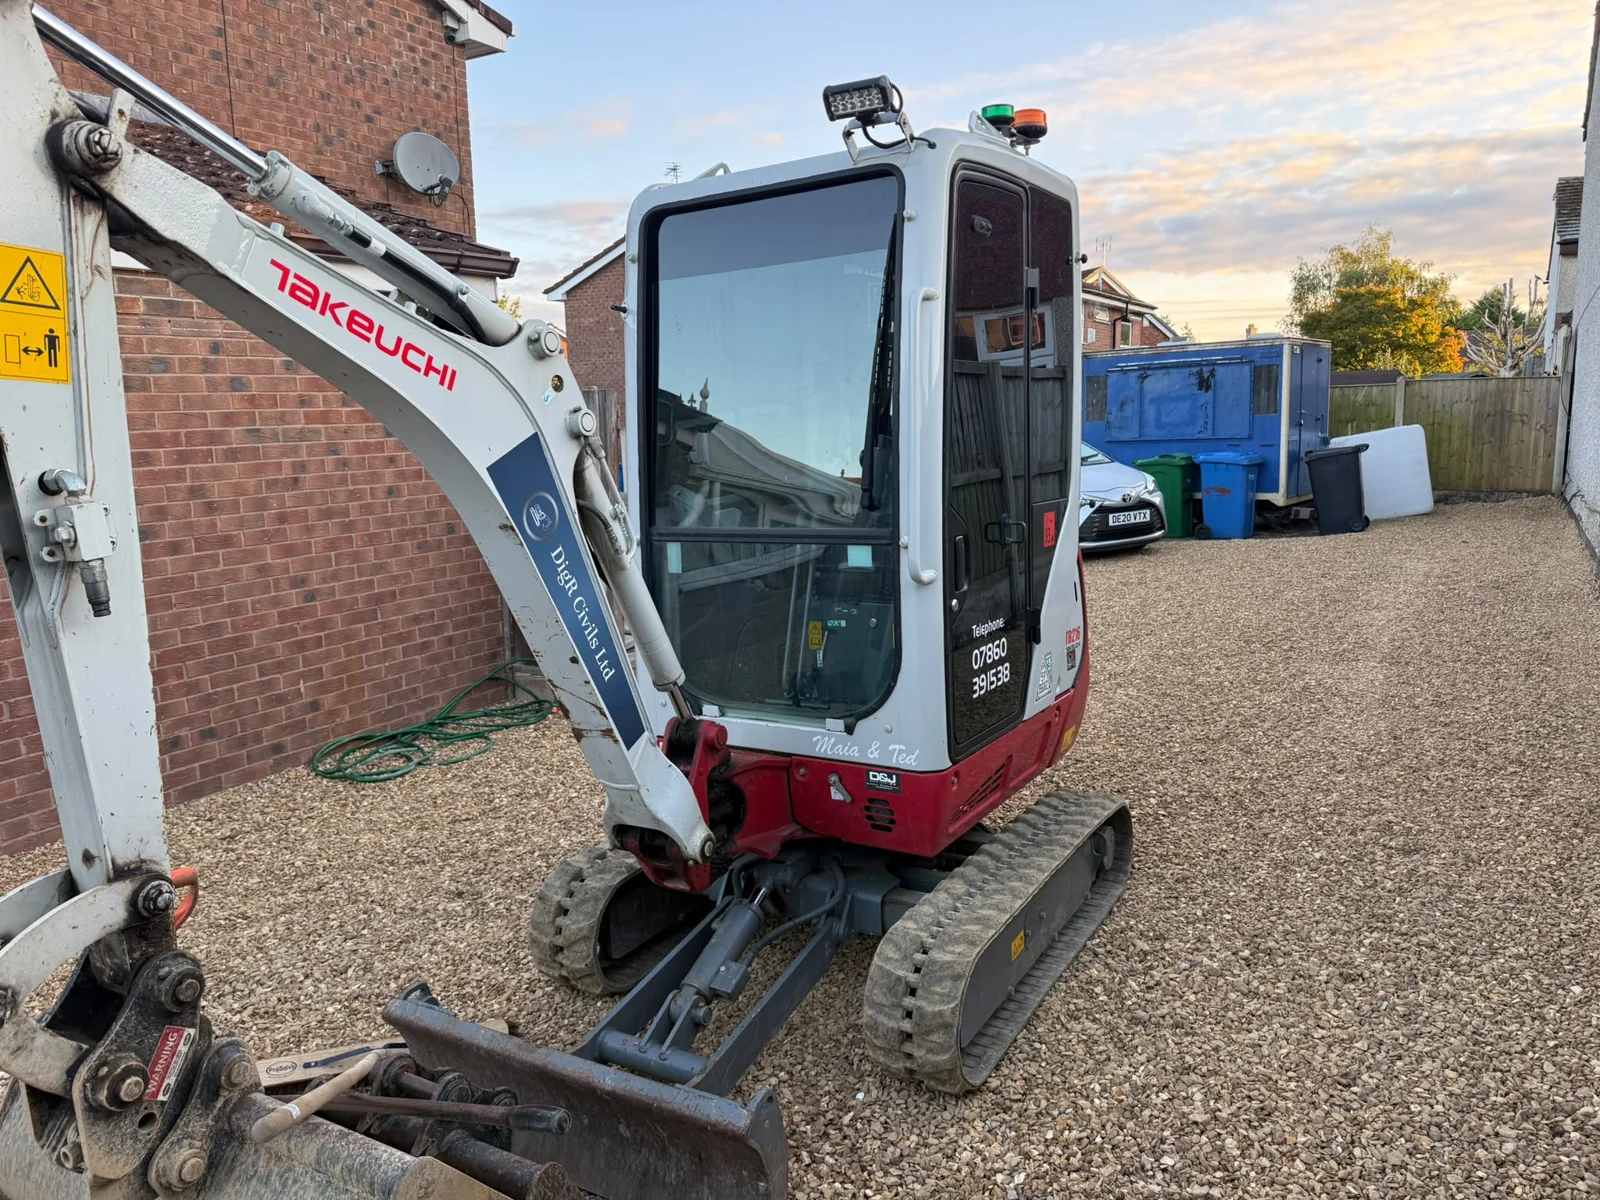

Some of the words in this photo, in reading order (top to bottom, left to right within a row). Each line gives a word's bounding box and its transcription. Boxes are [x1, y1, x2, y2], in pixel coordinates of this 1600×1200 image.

[1112, 513, 1131, 524] DE20
[1133, 511, 1147, 521] VTX
[550, 545, 578, 597] DigR
[573, 596, 599, 650] Civils
[594, 647, 616, 683] Ltd
[972, 637, 1007, 670] 07860
[972, 662, 1010, 699] 391538
[812, 735, 861, 757] Maia
[867, 741, 880, 758] &
[888, 744, 920, 766] Ted
[869, 771, 897, 784] D&J
[146, 1032, 178, 1093] WARNING
